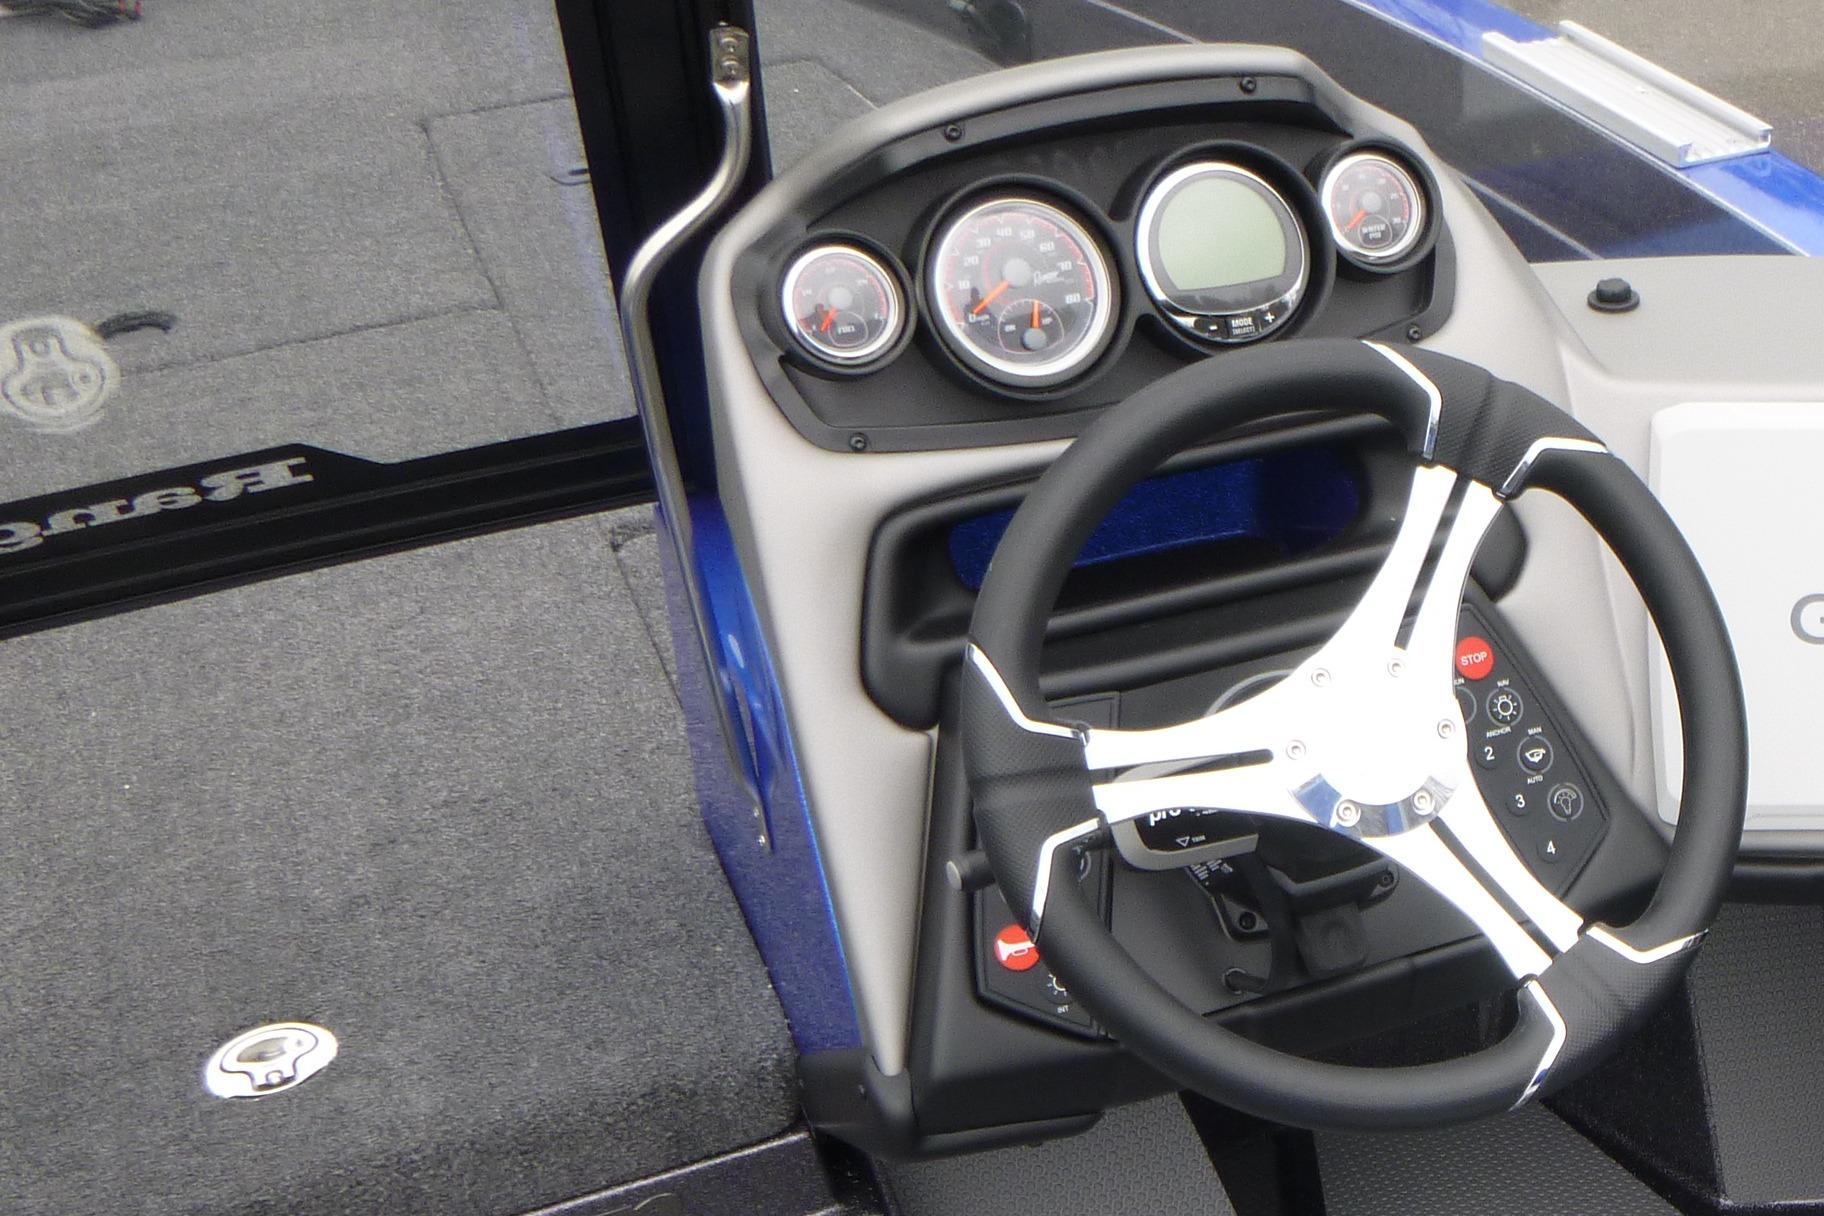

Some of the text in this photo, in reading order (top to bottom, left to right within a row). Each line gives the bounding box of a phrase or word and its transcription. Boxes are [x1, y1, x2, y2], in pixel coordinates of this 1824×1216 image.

[1460, 651, 1487, 666] STOP
[1486, 726, 1511, 738] ANCHOR
[1527, 726, 1542, 736] MAN
[1484, 746, 1495, 761] 2
[1527, 774, 1544, 785] AUTO
[1515, 794, 1526, 808] 3
[1546, 840, 1557, 855] 4
